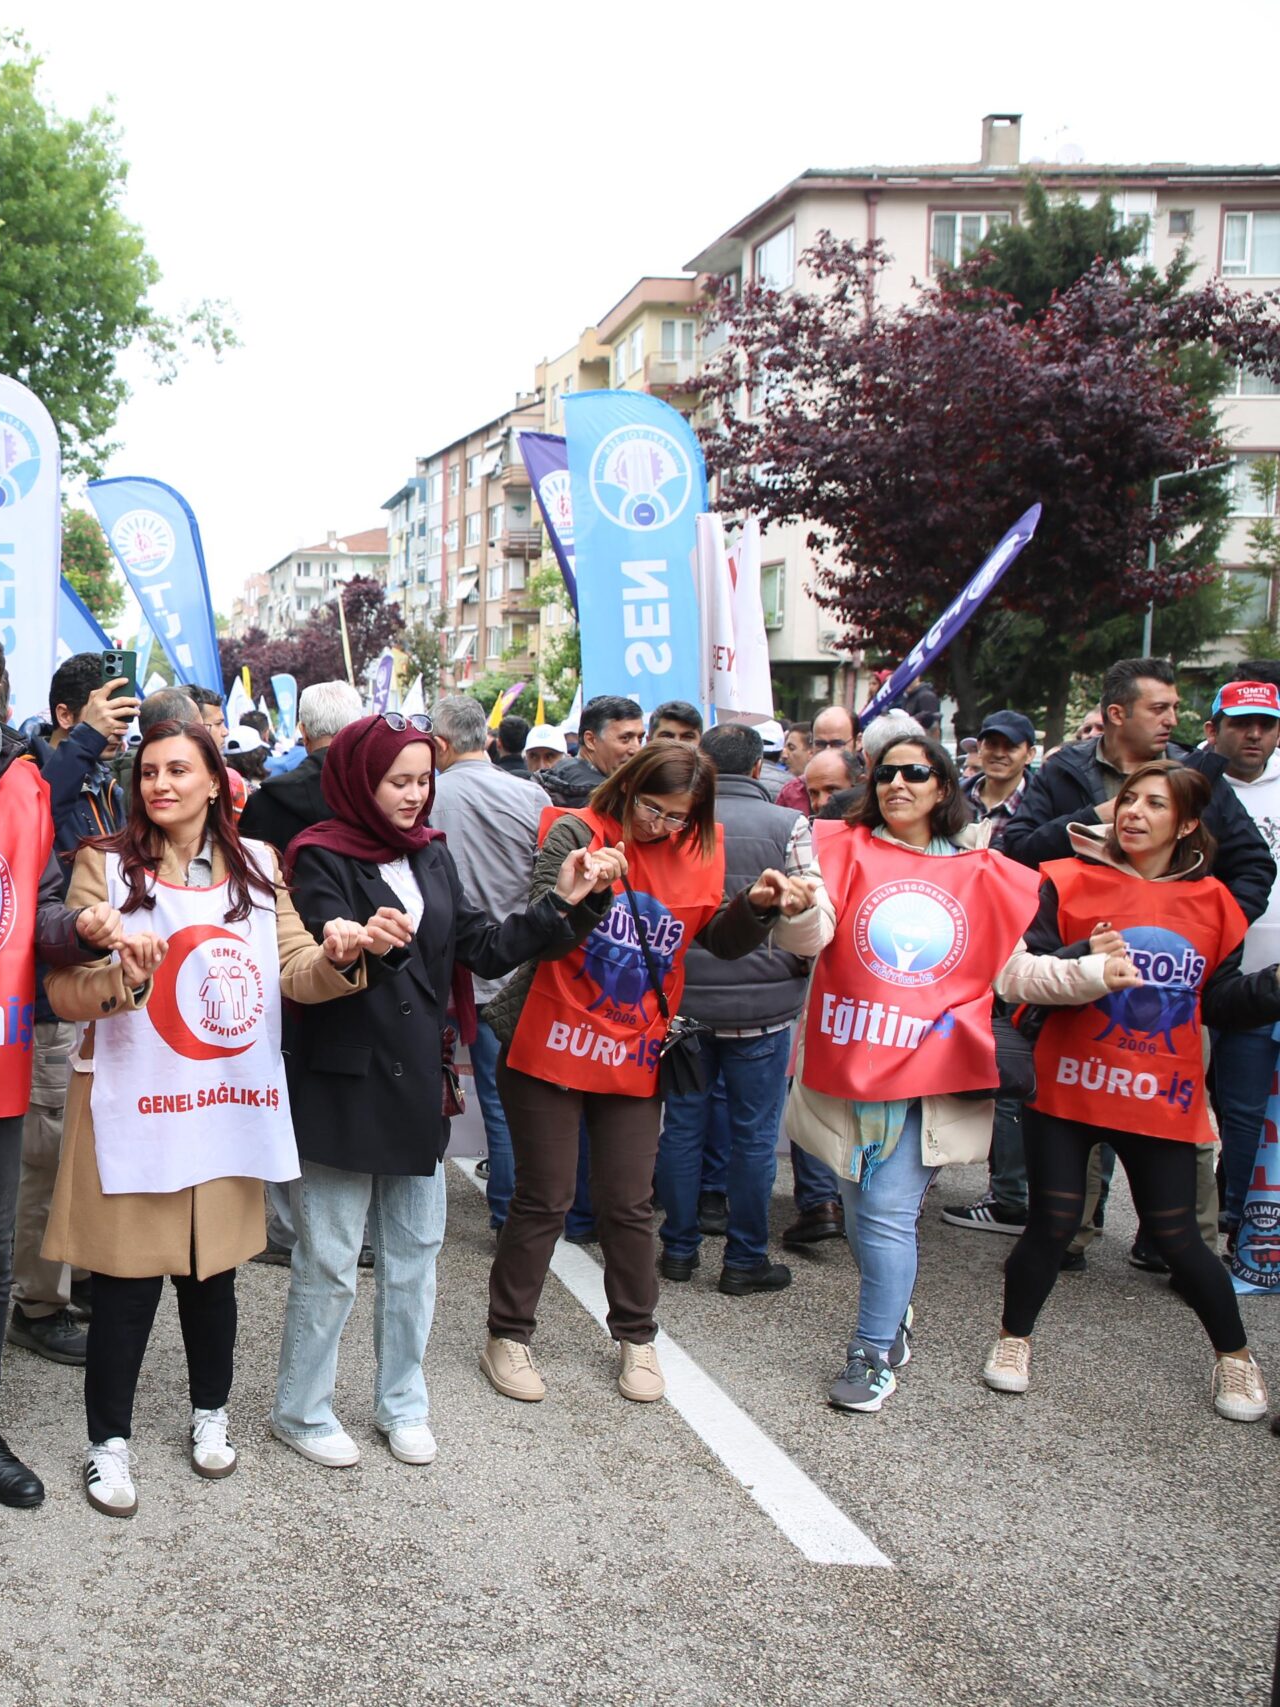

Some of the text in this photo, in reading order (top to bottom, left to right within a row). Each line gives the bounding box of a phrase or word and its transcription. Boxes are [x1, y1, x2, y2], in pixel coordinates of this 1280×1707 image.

[862, 902, 874, 916] VE
[873, 885, 898, 904] BİLİM
[942, 918, 965, 970] SENDİKASI
[604, 1008, 637, 1025] 2006
[1117, 1036, 1158, 1055] 2006
[138, 1081, 279, 1114] GENEL SAĞLIK-İŞ
[1243, 1204, 1280, 1220] ÜMTİS
[1239, 1267, 1280, 1287] ÇİLERİ
